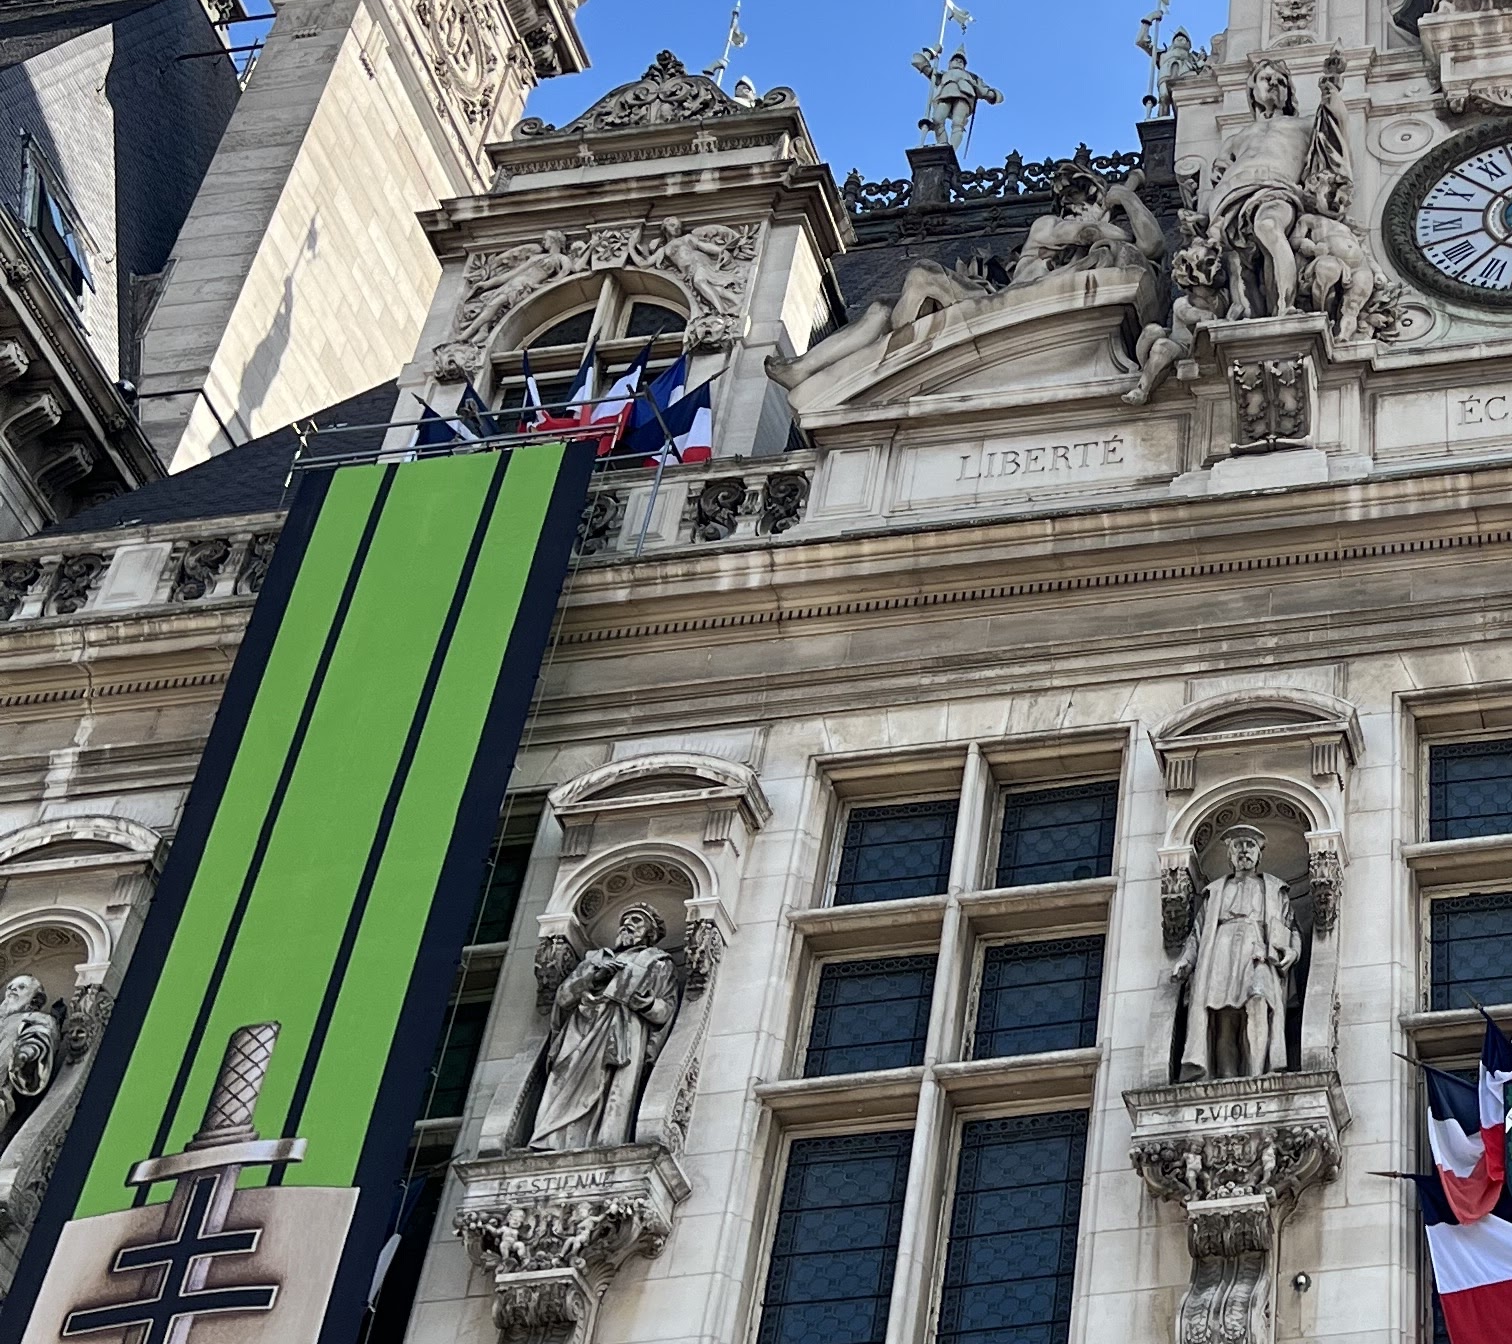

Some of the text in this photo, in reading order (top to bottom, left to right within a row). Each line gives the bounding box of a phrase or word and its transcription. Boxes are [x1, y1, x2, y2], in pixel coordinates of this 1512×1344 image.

[1476, 159, 1507, 183] XI
[1444, 187, 1476, 201] X
[1432, 217, 1463, 233] IX
[1441, 239, 1478, 265] VIII
[1478, 257, 1509, 283] VII
[956, 434, 1124, 482] LIBERTÉ
